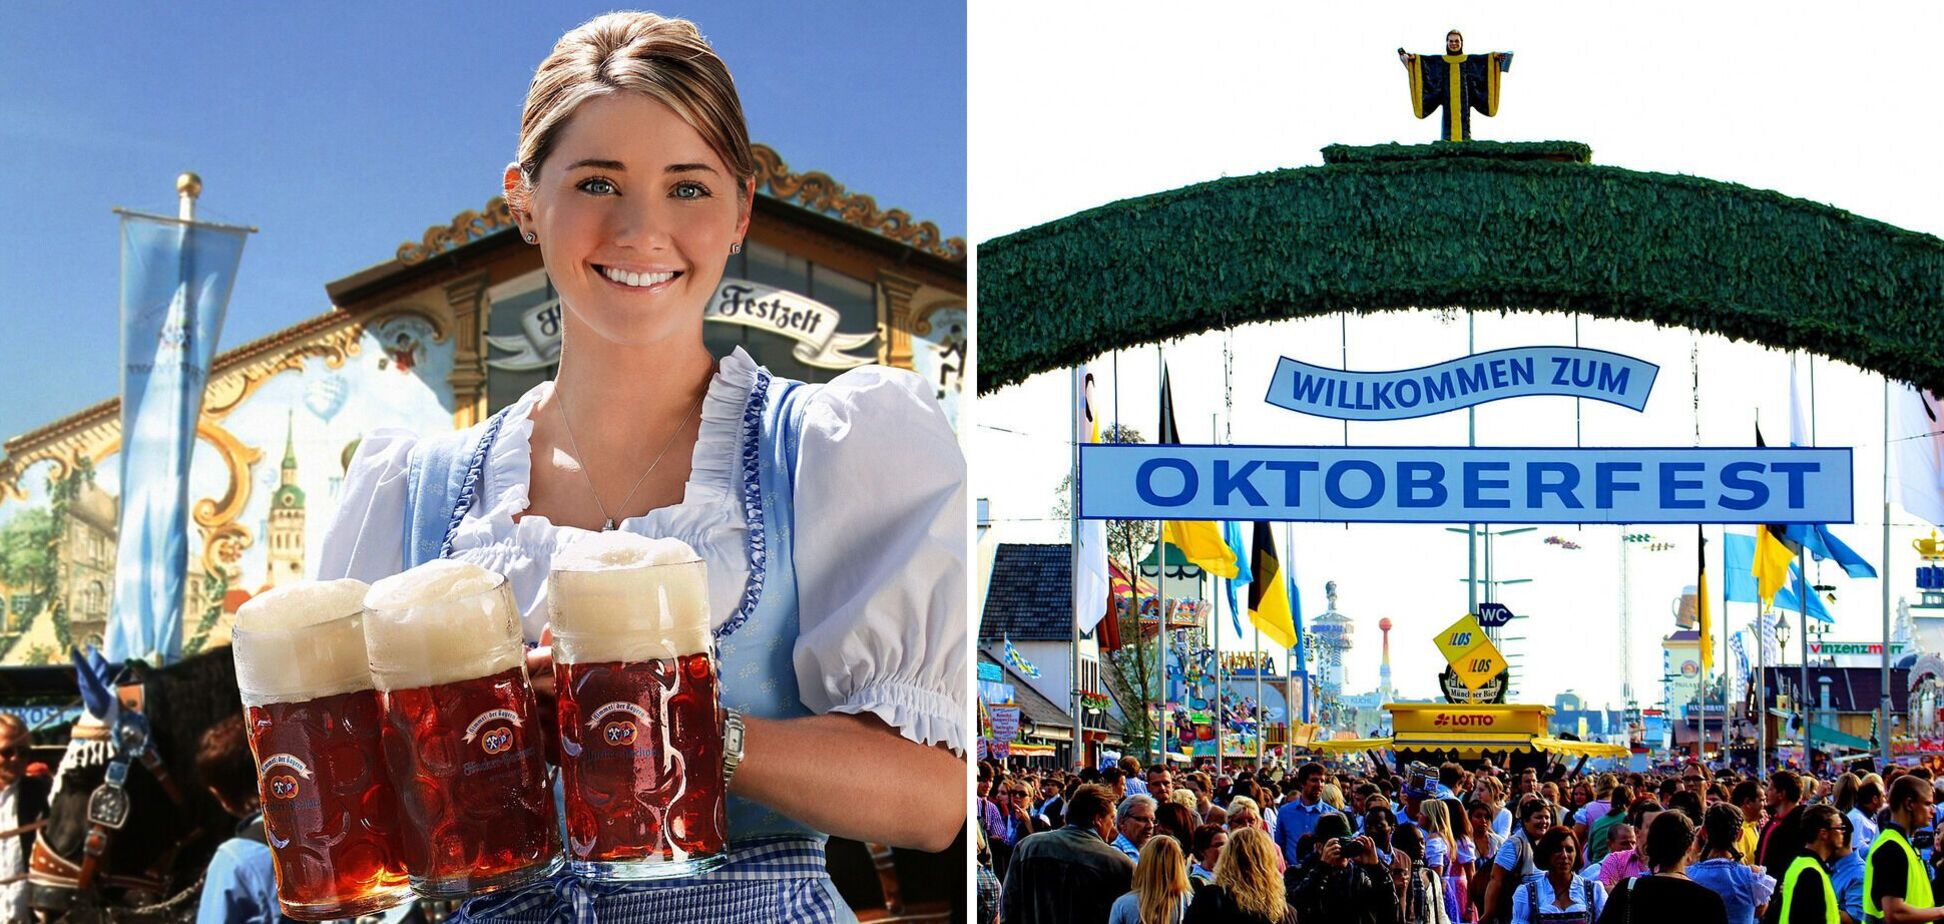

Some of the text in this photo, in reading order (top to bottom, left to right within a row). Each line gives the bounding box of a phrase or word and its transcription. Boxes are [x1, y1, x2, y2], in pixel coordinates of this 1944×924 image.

[719, 285, 822, 334] Festzelt
[1293, 357, 1631, 410] WILLKOMMEN ZUM
[1135, 457, 1820, 509] OKTOBERFEST
[1481, 608, 1507, 622] WC
[1810, 643, 1904, 654] vinzenzmrr
[1452, 715, 1494, 725] LOTTO
